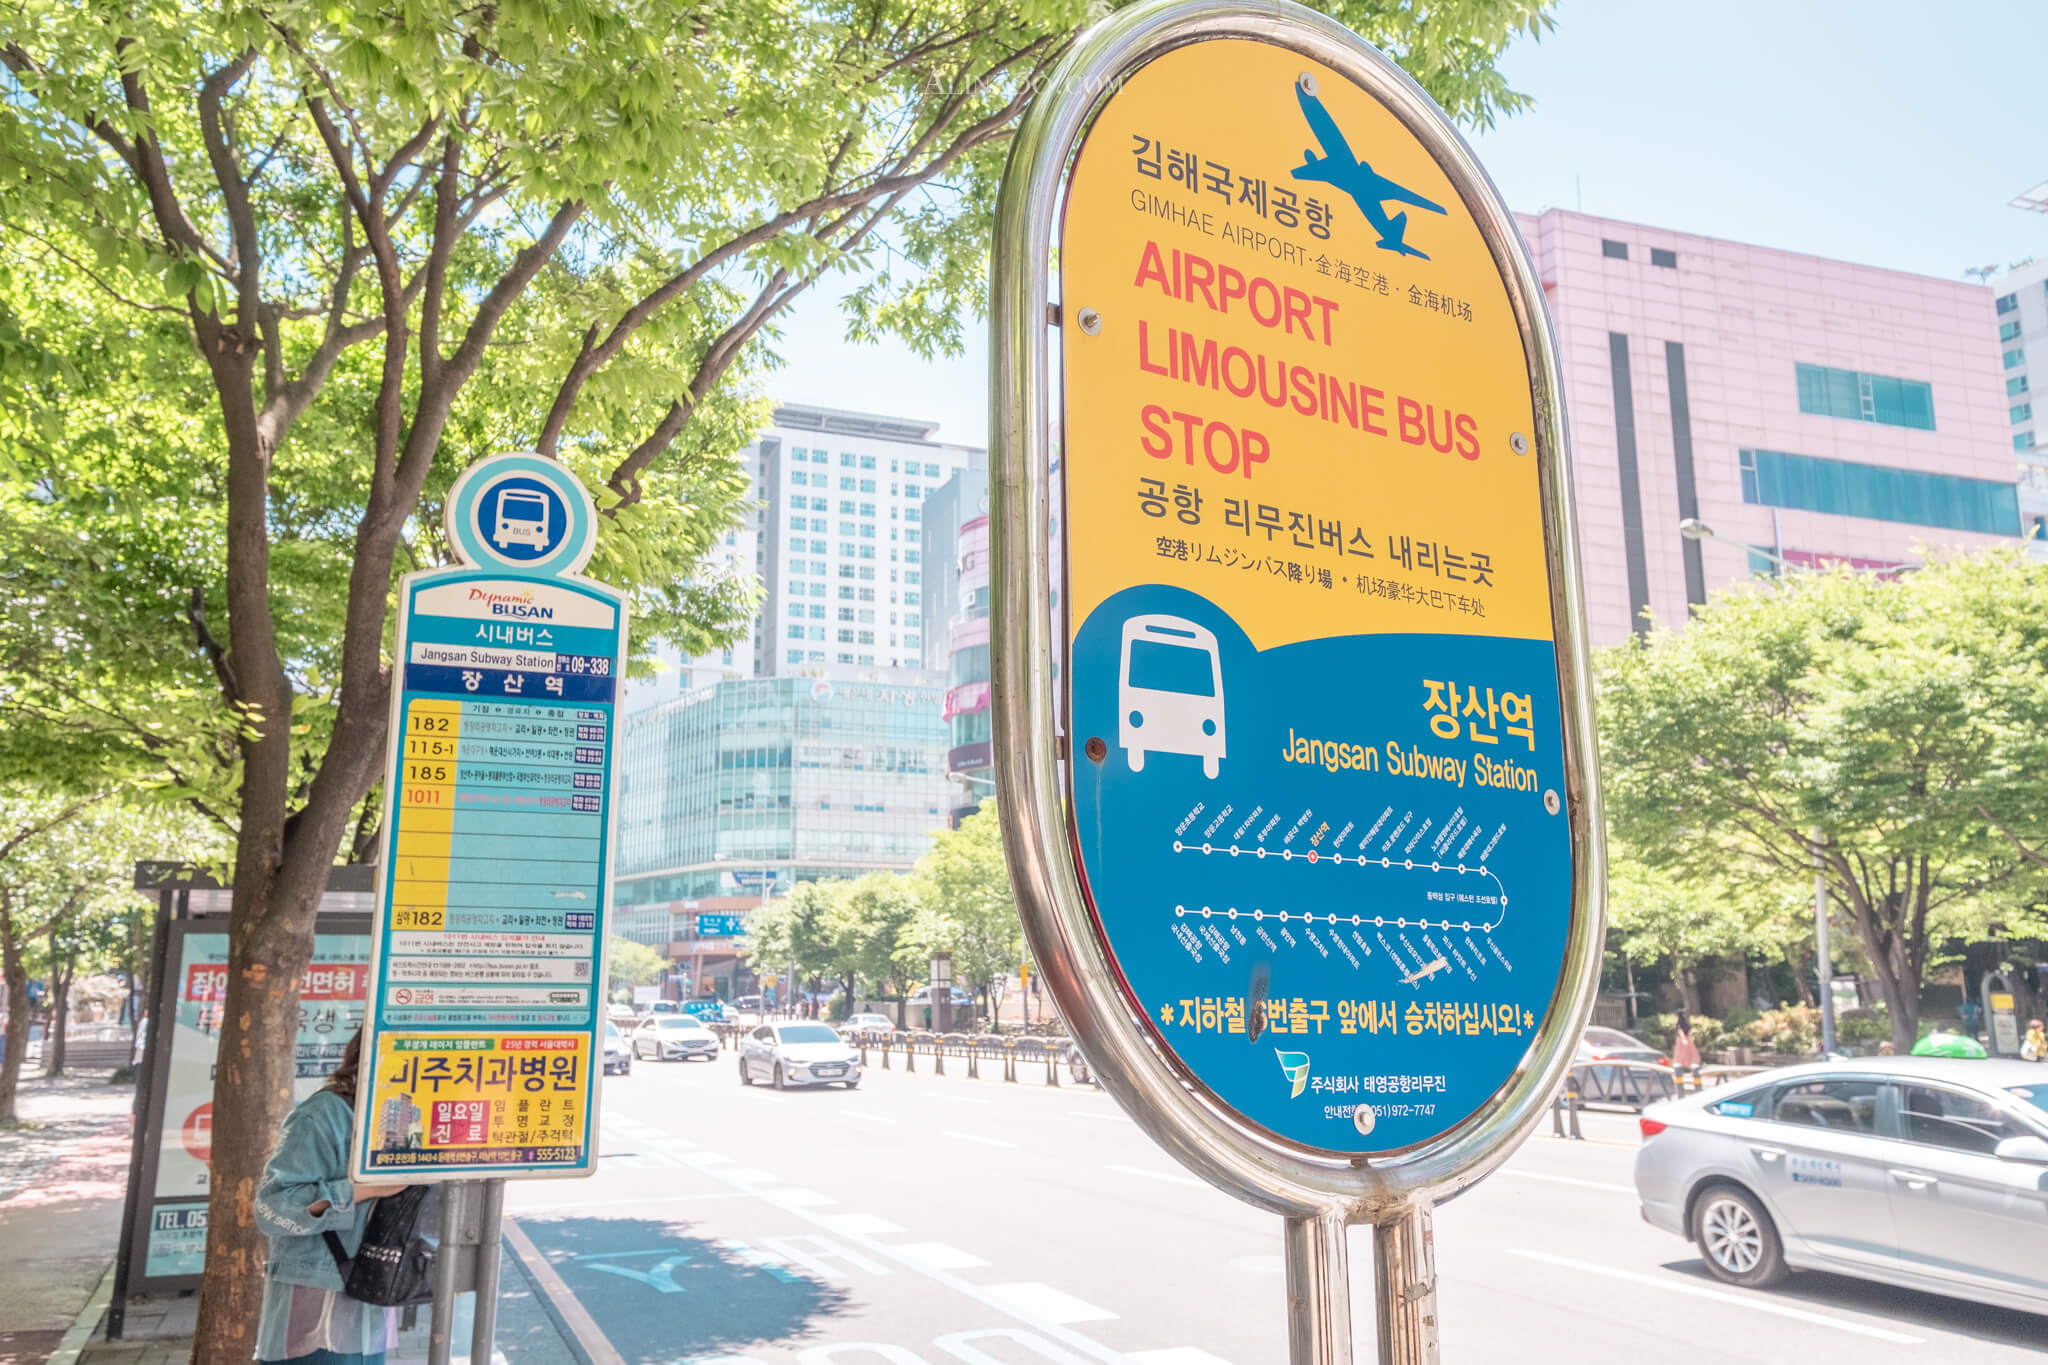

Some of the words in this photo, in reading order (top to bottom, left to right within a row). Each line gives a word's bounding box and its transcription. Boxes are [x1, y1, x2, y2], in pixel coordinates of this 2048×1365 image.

[1131, 134, 1334, 241] 김해국제공항
[1131, 189, 1214, 236] GIMHAE
[1222, 221, 1306, 268] AIRPORT
[1408, 285, 1473, 322] 金海机场
[1134, 240, 1339, 347] AIRPORT
[1139, 319, 1388, 437] LIMOUSINE
[1397, 395, 1481, 461] BUS
[1140, 404, 1271, 480] STOP
[512, 526, 532, 537] BUS
[1137, 476, 1204, 527] 공항
[1224, 498, 1375, 559] 리무진버스
[1388, 534, 1495, 588] 내리는곳
[468, 588, 535, 606] Dynamic
[1356, 573, 1486, 619] 机场豪华大巴下车处
[492, 603, 553, 620] BUSAN
[476, 624, 553, 646] 시내버스
[420, 648, 468, 665] Jangsan
[471, 651, 513, 667] Subway
[516, 654, 554, 669] Station
[571, 657, 609, 675] 09-338
[461, 671, 563, 696] 장산역
[413, 716, 449, 732] 182
[1422, 679, 1536, 752] 장산역
[410, 740, 454, 755] 115-1
[1282, 728, 1379, 772] Jangsan
[1386, 741, 1467, 788] Subway
[1474, 753, 1538, 792] Station
[410, 766, 447, 780] 185
[407, 789, 440, 804] 1011
[1309, 821, 1331, 848] 장산역
[412, 911, 443, 926] 182
[1179, 997, 1247, 1034] 지하철
[1338, 999, 1397, 1035] 앞에서
[1404, 1001, 1523, 1037] 승차하십시오!
[1311, 1075, 1359, 1094] 주식회사
[1364, 1075, 1446, 1094] 태영공항리무진
[437, 1102, 484, 1122] 일요일
[159, 1212, 184, 1230] TEL.
